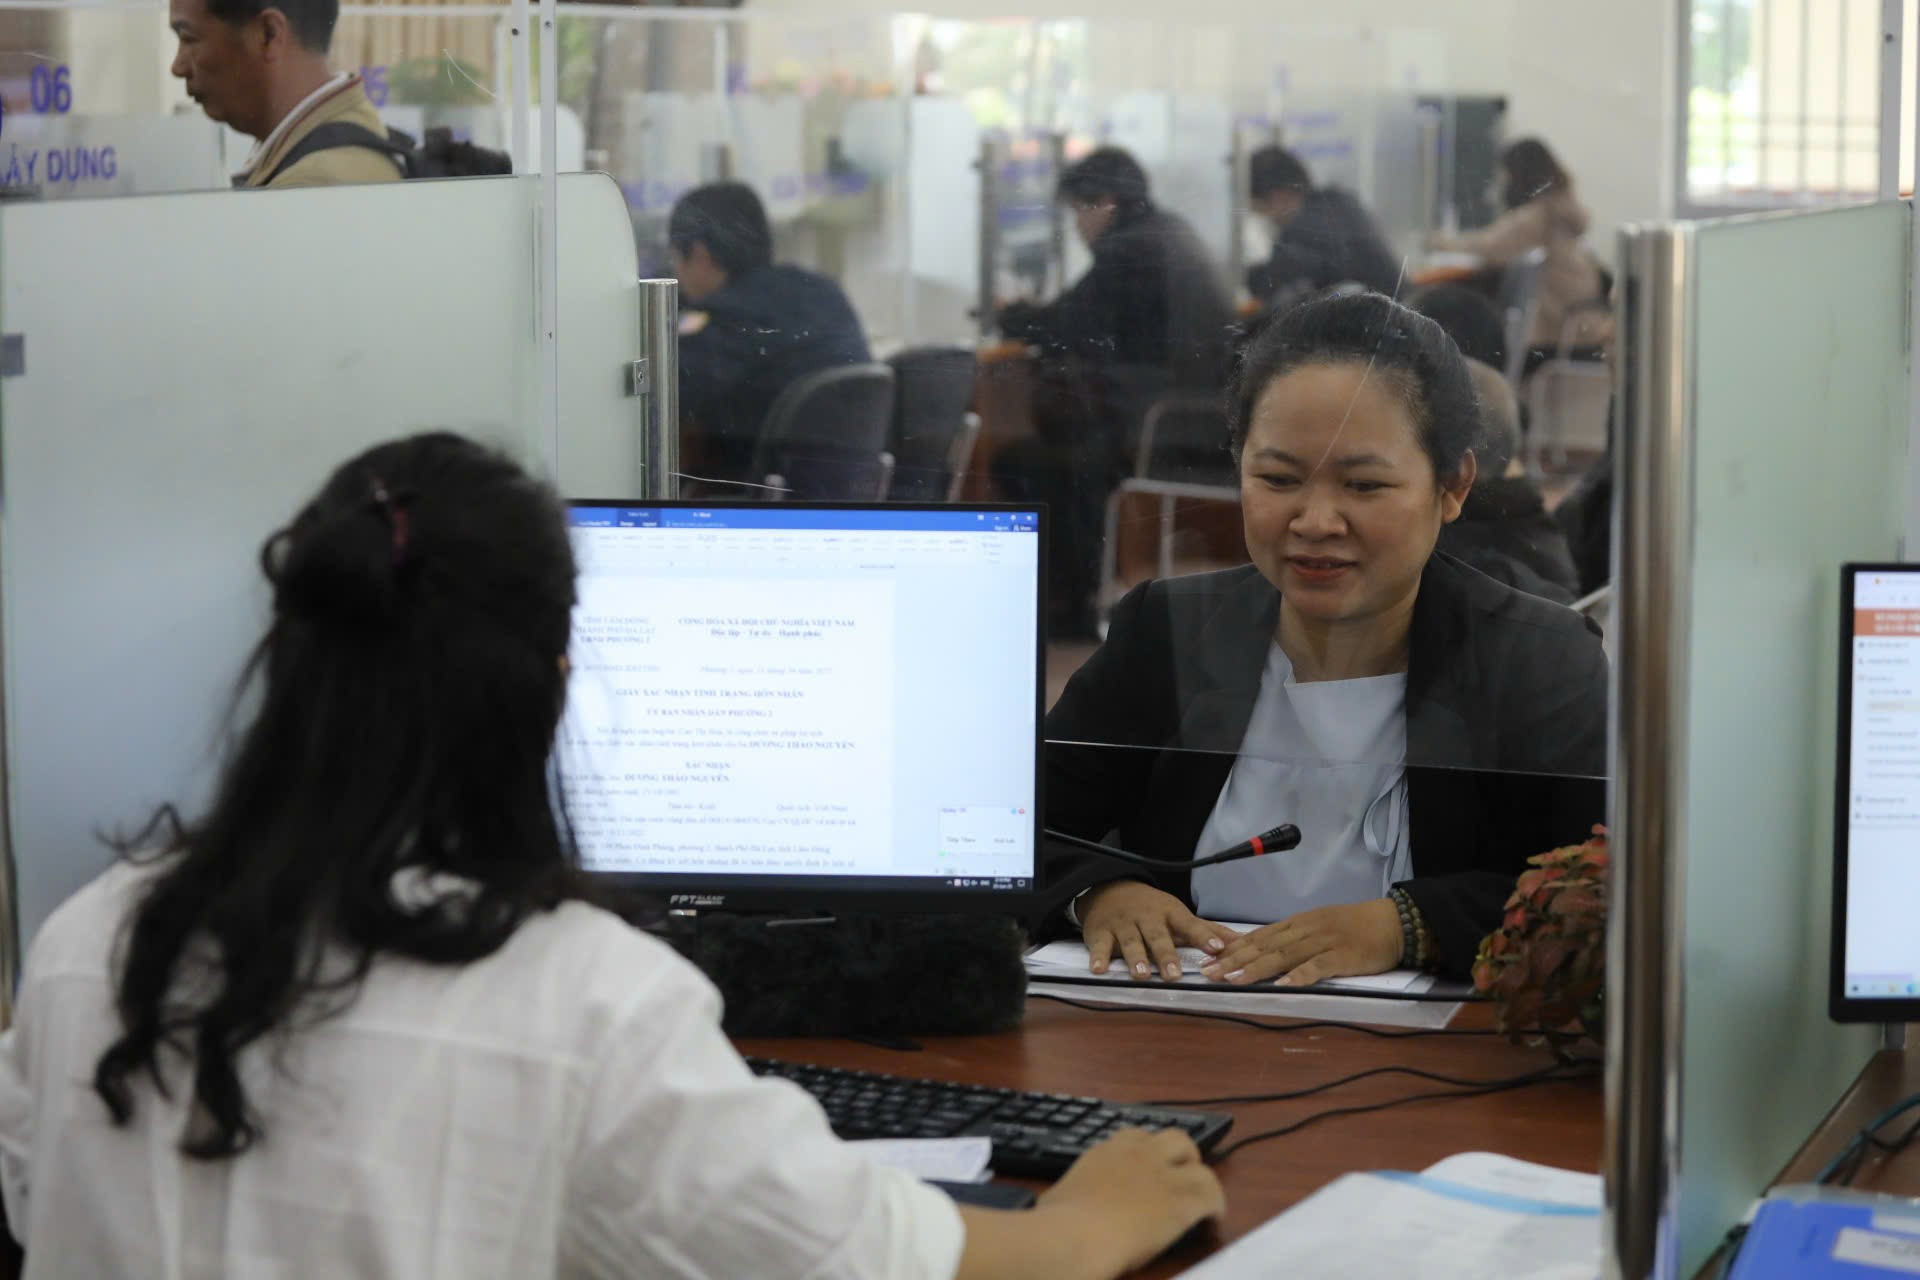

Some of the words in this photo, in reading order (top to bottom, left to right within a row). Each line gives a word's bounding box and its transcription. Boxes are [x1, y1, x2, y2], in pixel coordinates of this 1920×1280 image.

[30, 65, 72, 113] 06
[0, 143, 38, 185] ÂY
[670, 894, 697, 904] FPT
